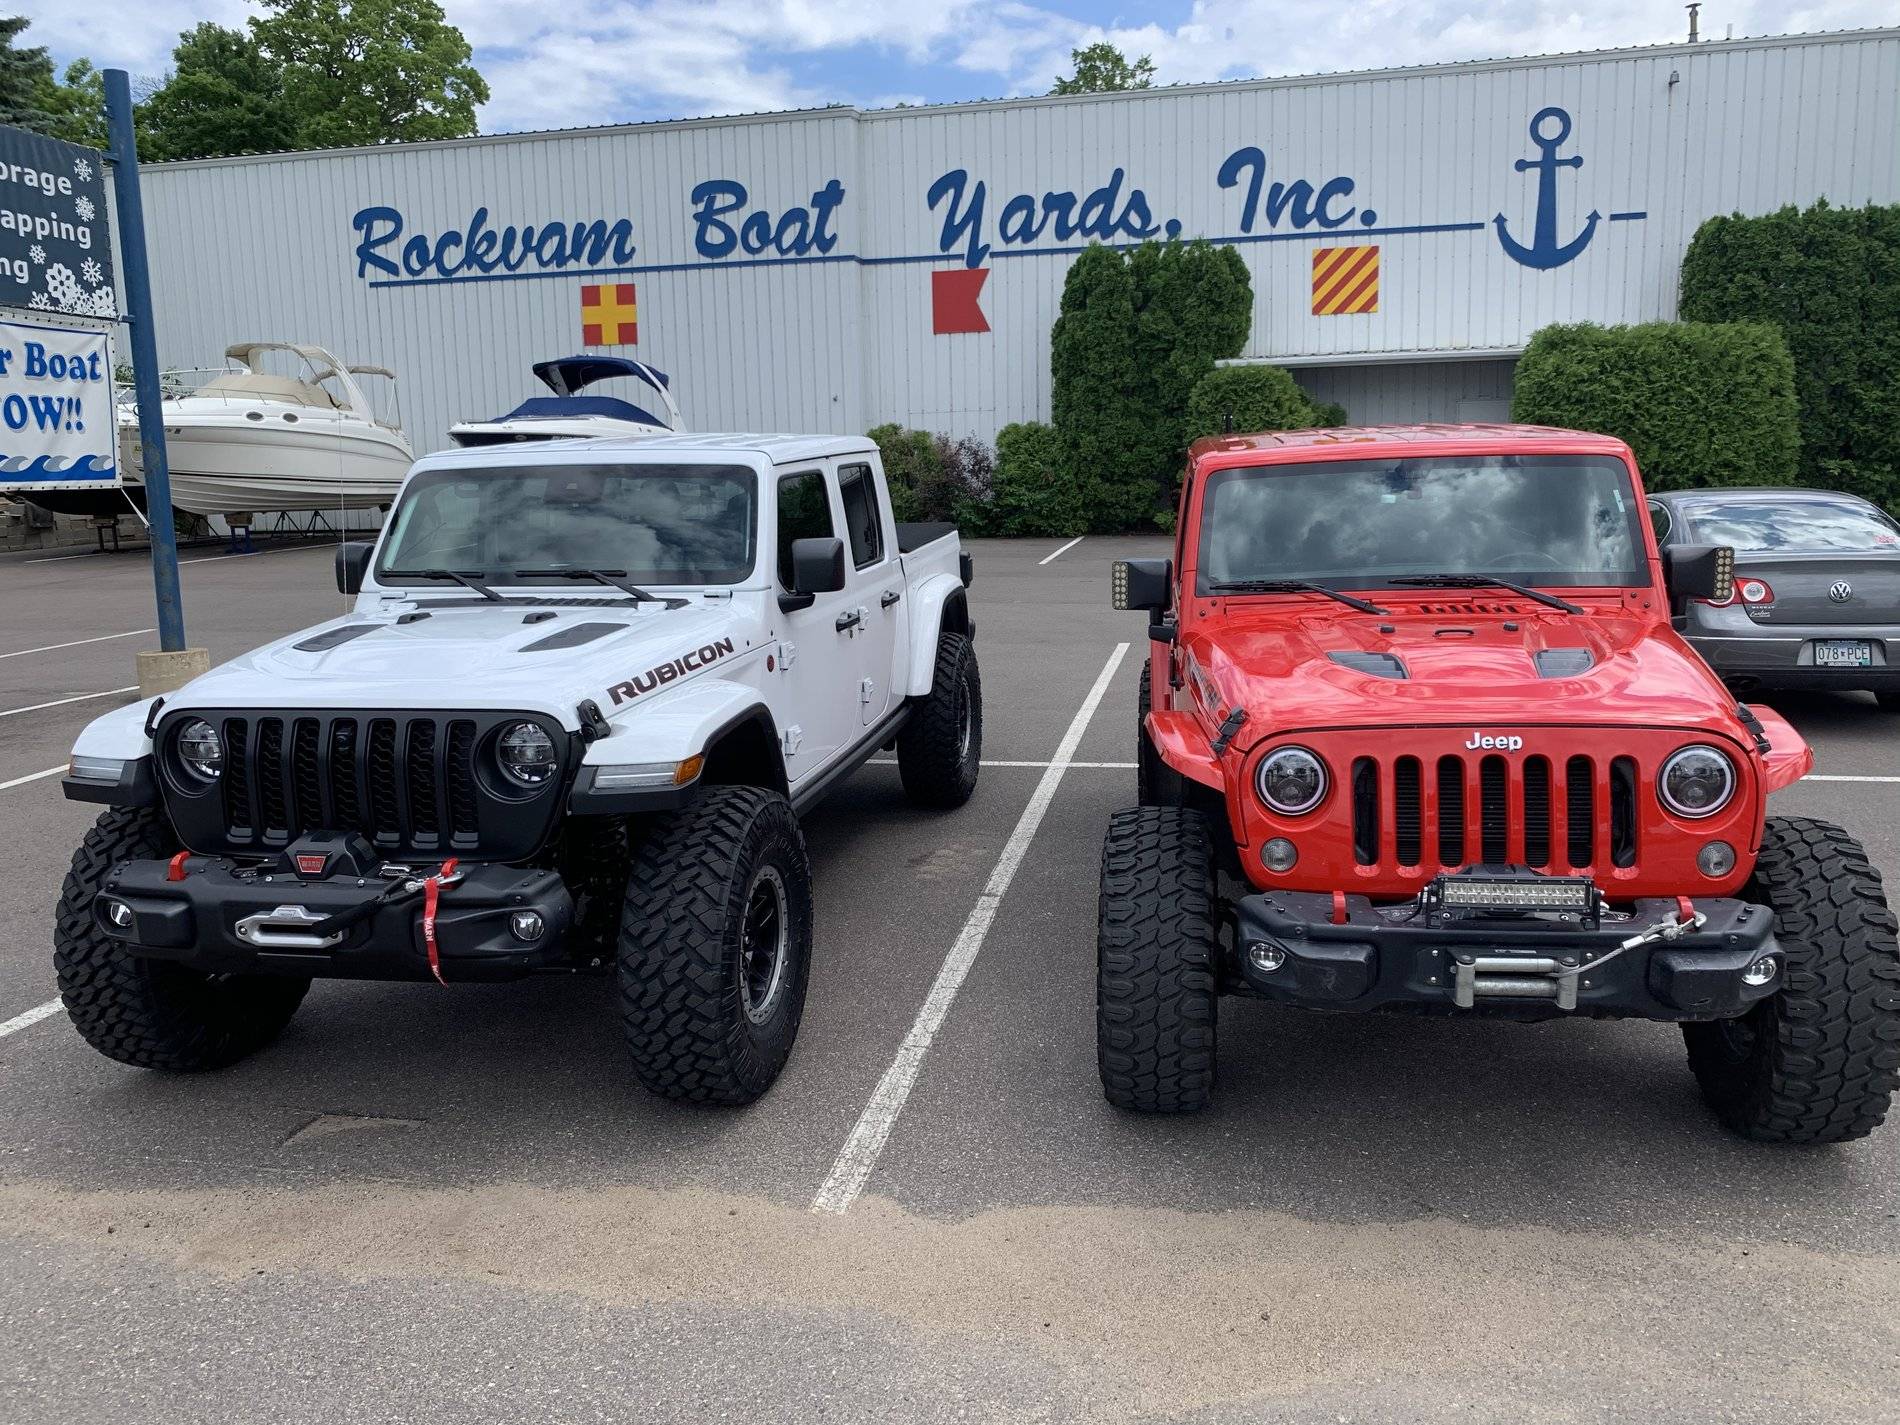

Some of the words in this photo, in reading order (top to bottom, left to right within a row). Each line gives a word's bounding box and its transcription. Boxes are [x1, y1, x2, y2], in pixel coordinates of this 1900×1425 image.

[0, 209, 92, 250] apping
[353, 206, 636, 279] Rockvam
[691, 179, 845, 259] Boat
[927, 167, 1182, 269] Yards,
[1216, 146, 1377, 233] Inc.
[24, 342, 103, 381] Boat
[3, 394, 84, 432] OW!!
[606, 637, 735, 706] RUBICON
[1465, 732, 1523, 752] Jeep
[424, 917, 434, 942] WARN
